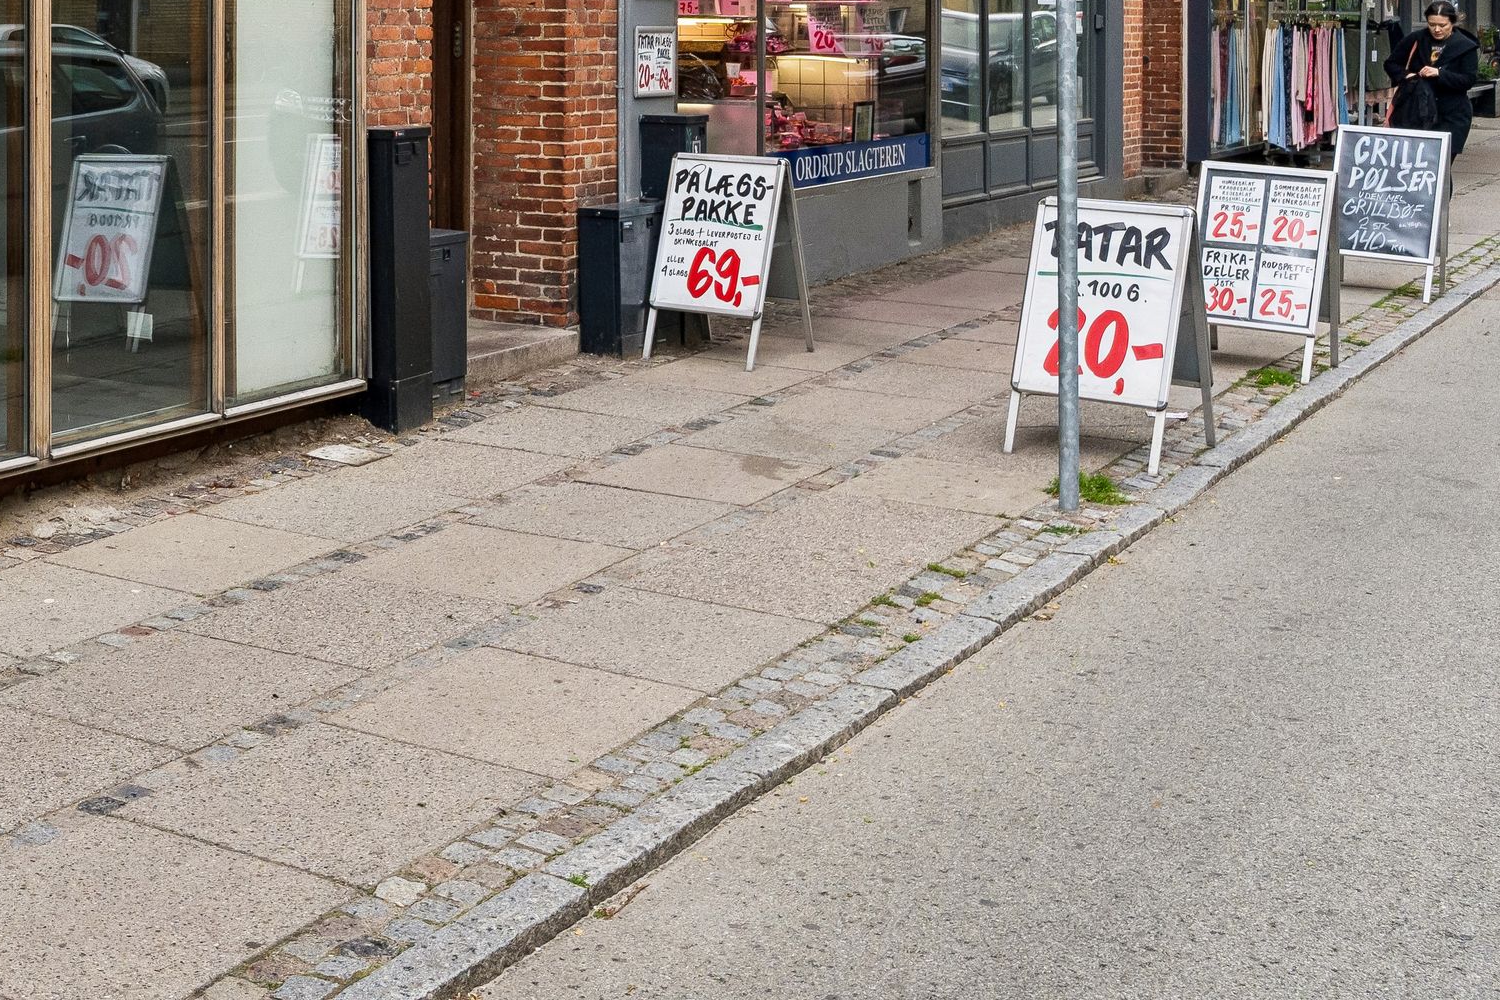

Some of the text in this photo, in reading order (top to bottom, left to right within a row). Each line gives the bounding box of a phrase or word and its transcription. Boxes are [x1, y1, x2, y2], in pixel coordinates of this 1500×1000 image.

[1354, 135, 1428, 169] GRILL
[795, 143, 906, 181] ORDRUP SLAGTEREN
[1273, 184, 1322, 193] SOMMERSALAT
[1347, 166, 1437, 196] PØLSER
[1358, 191, 1383, 201] UDEN
[680, 196, 756, 225] PAKKE
[668, 223, 675, 236] 3
[675, 227, 695, 236] SLAGS
[706, 228, 751, 241] LEVERPOSTEJ
[1212, 211, 1258, 241] 25,-
[1271, 215, 1318, 248] 20,-
[1358, 216, 1391, 232] 2 STK
[666, 256, 685, 264] ELLER
[1205, 249, 1254, 265] FRIKA-
[661, 265, 688, 278] 4 SLAGS
[687, 246, 760, 308] 69,-
[1203, 264, 1250, 281] DELLER
[1273, 270, 1300, 281] FILET
[1087, 279, 1122, 298] 100
[1259, 288, 1307, 322] 25,-
